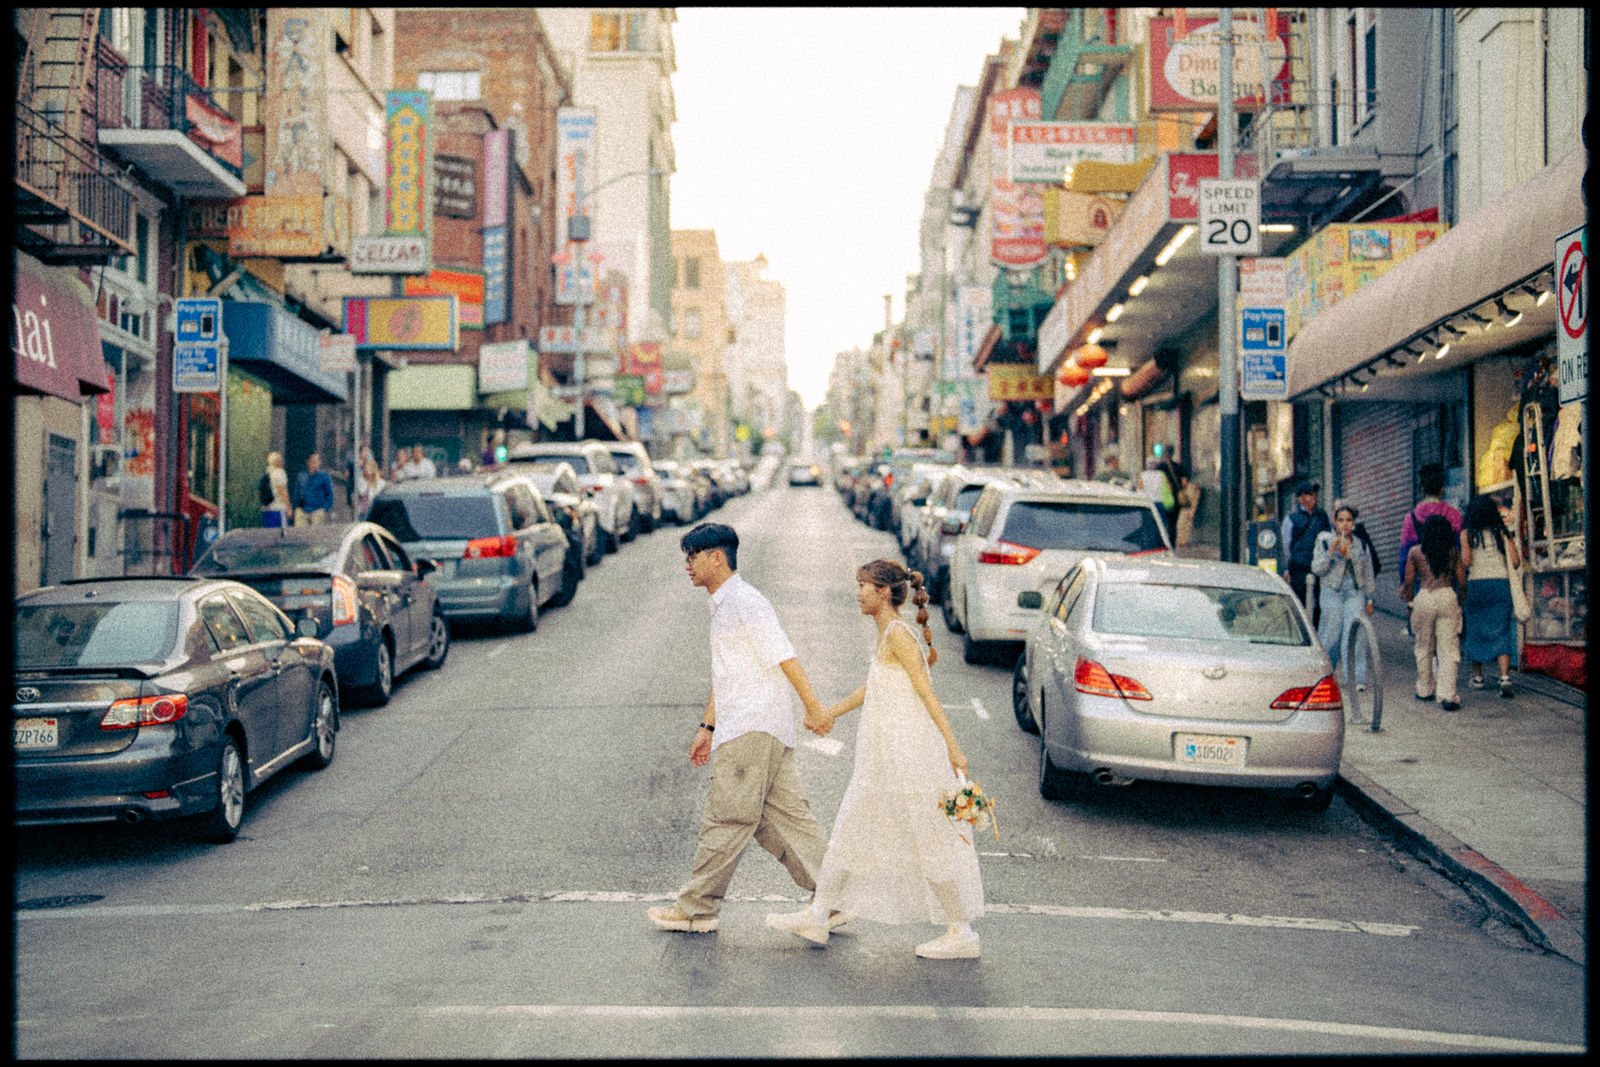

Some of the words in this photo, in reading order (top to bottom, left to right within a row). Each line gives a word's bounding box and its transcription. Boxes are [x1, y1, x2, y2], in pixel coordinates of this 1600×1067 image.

[1179, 50, 1243, 72] Dinnr
[399, 115, 414, 226] WAVERLY
[1204, 187, 1254, 199] SPEED
[1209, 202, 1247, 215] LIMIT
[1208, 219, 1251, 245] 20
[356, 245, 421, 262] CELLAR
[178, 303, 195, 314] Pay
[1244, 310, 1260, 322] Pay
[1261, 310, 1283, 321] here
[1562, 358, 1574, 385] ON
